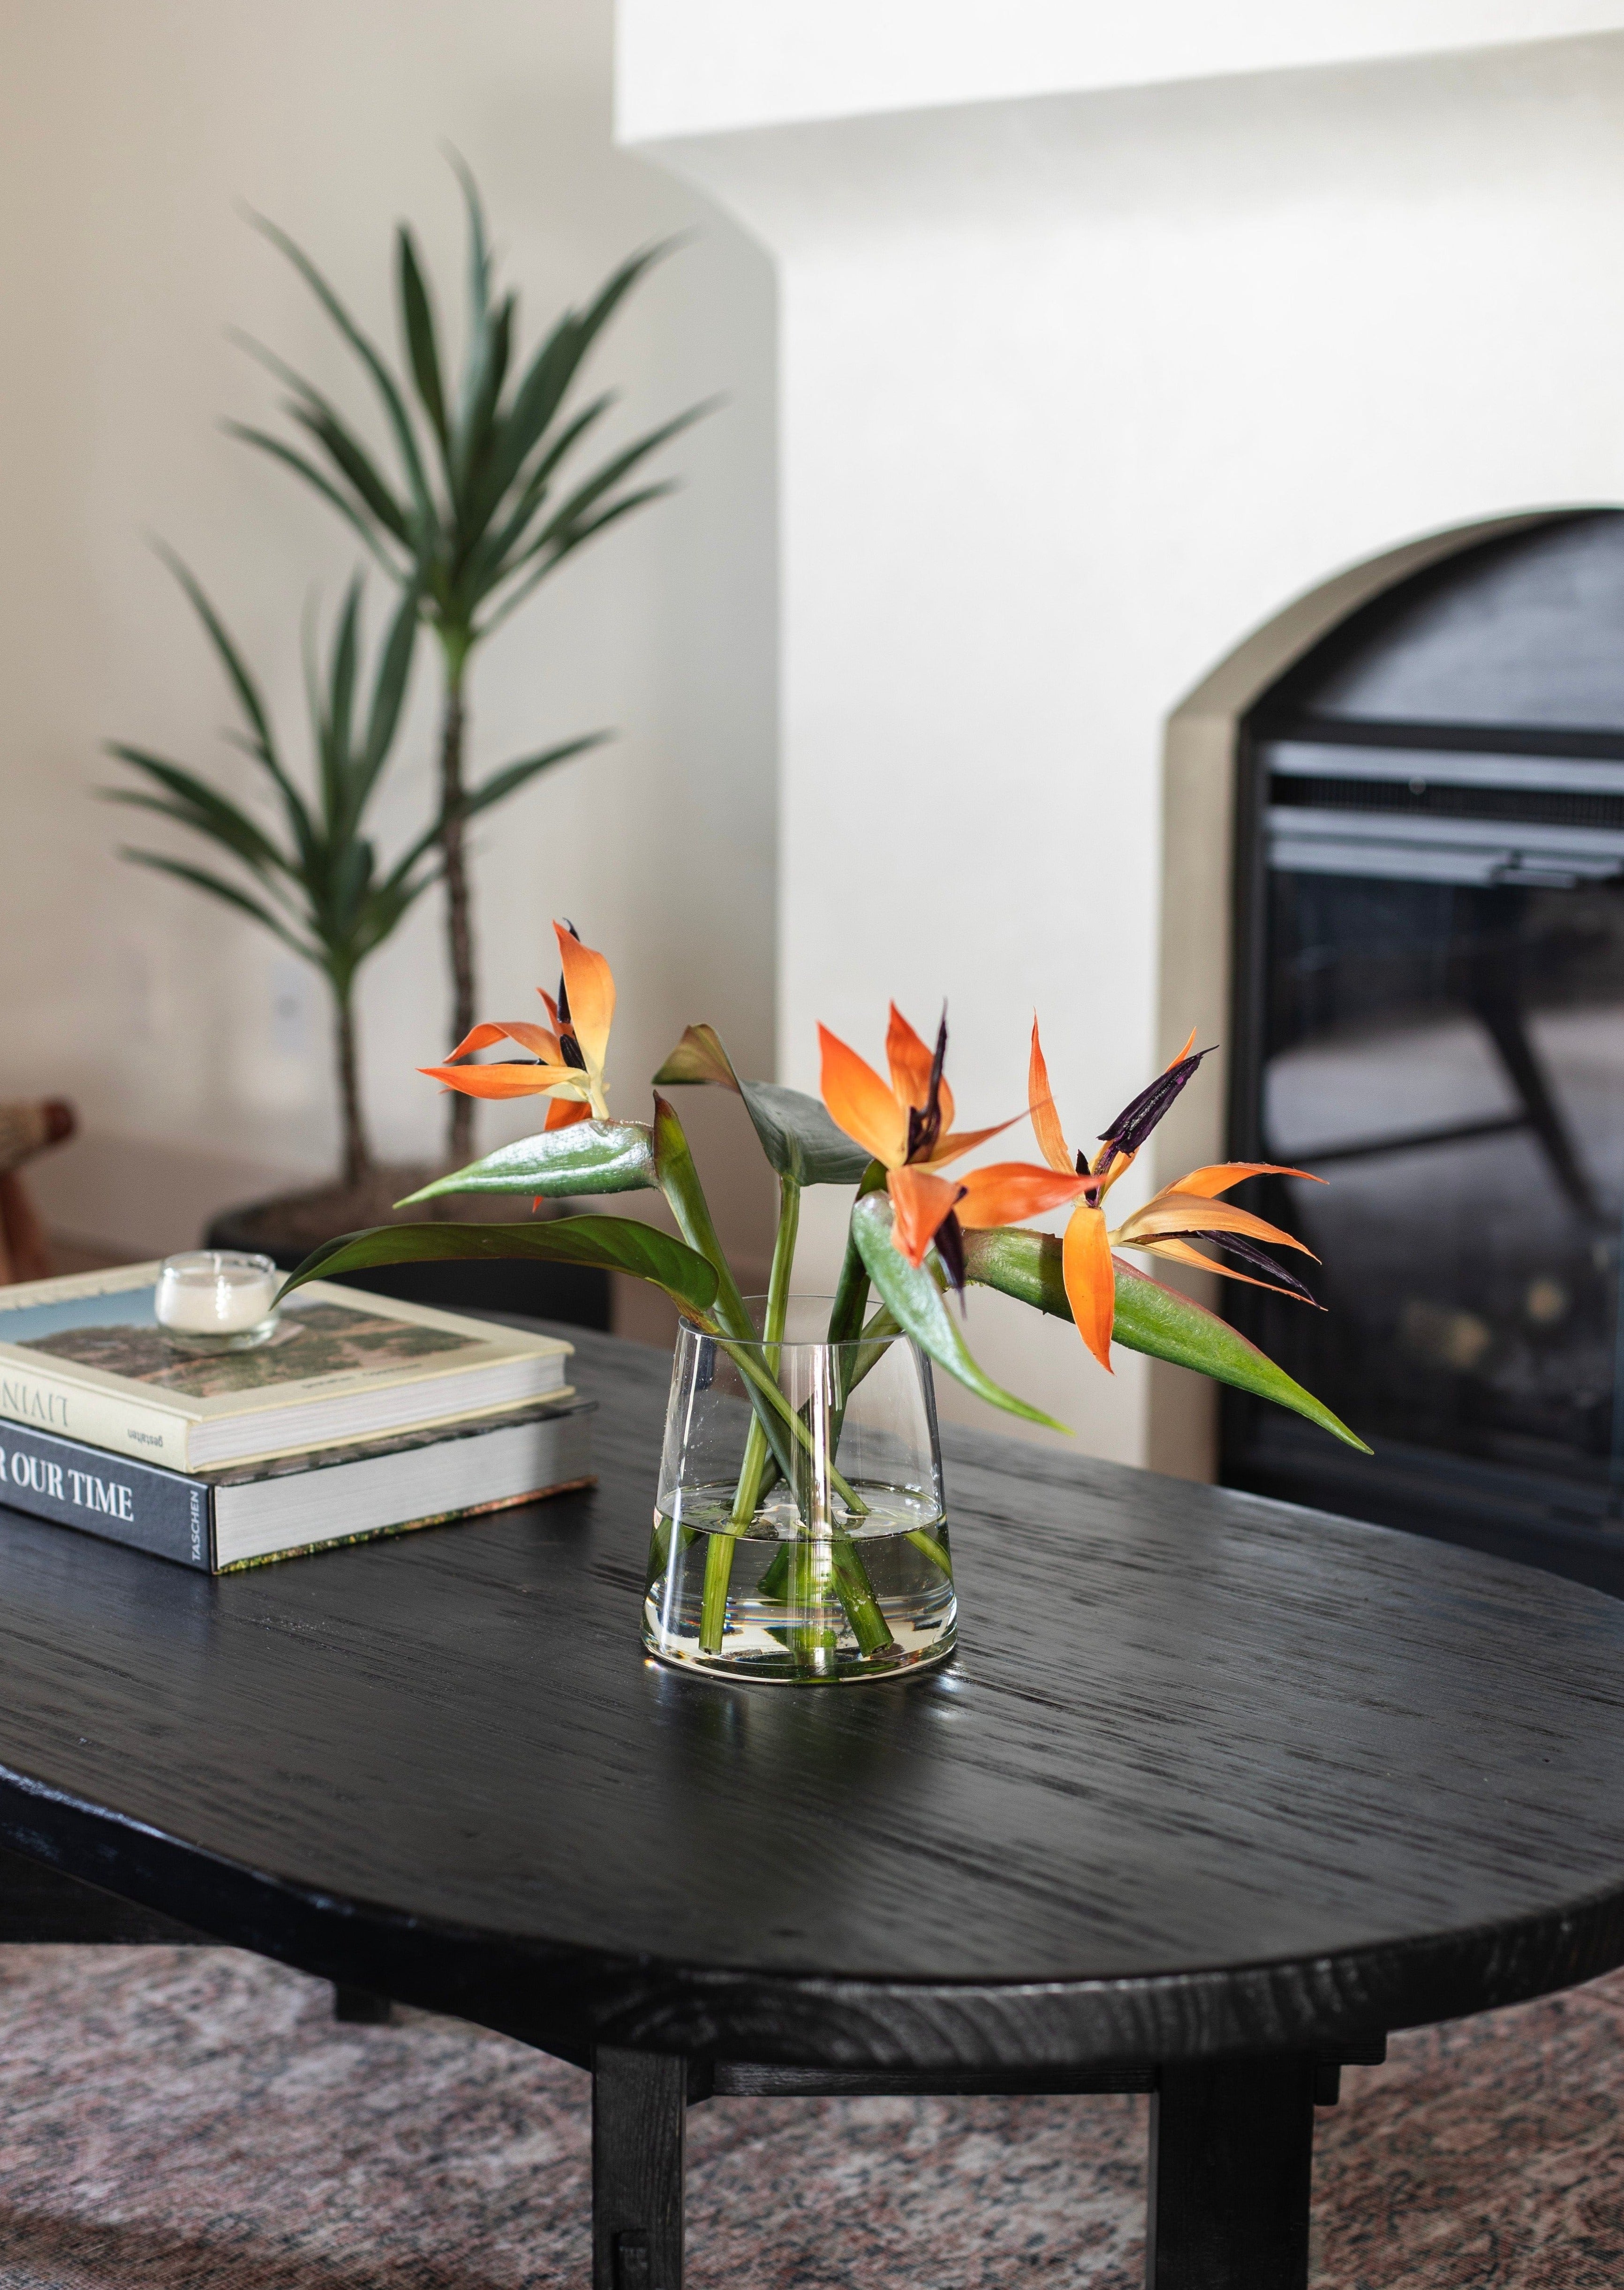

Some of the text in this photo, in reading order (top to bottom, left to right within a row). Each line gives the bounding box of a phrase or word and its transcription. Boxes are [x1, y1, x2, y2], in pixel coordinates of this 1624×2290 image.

[128, 1428, 163, 1447] gestalten
[11, 1451, 65, 1500] OUR
[68, 1468, 134, 1522] TIME
[190, 1490, 201, 1561] TASCHEN
